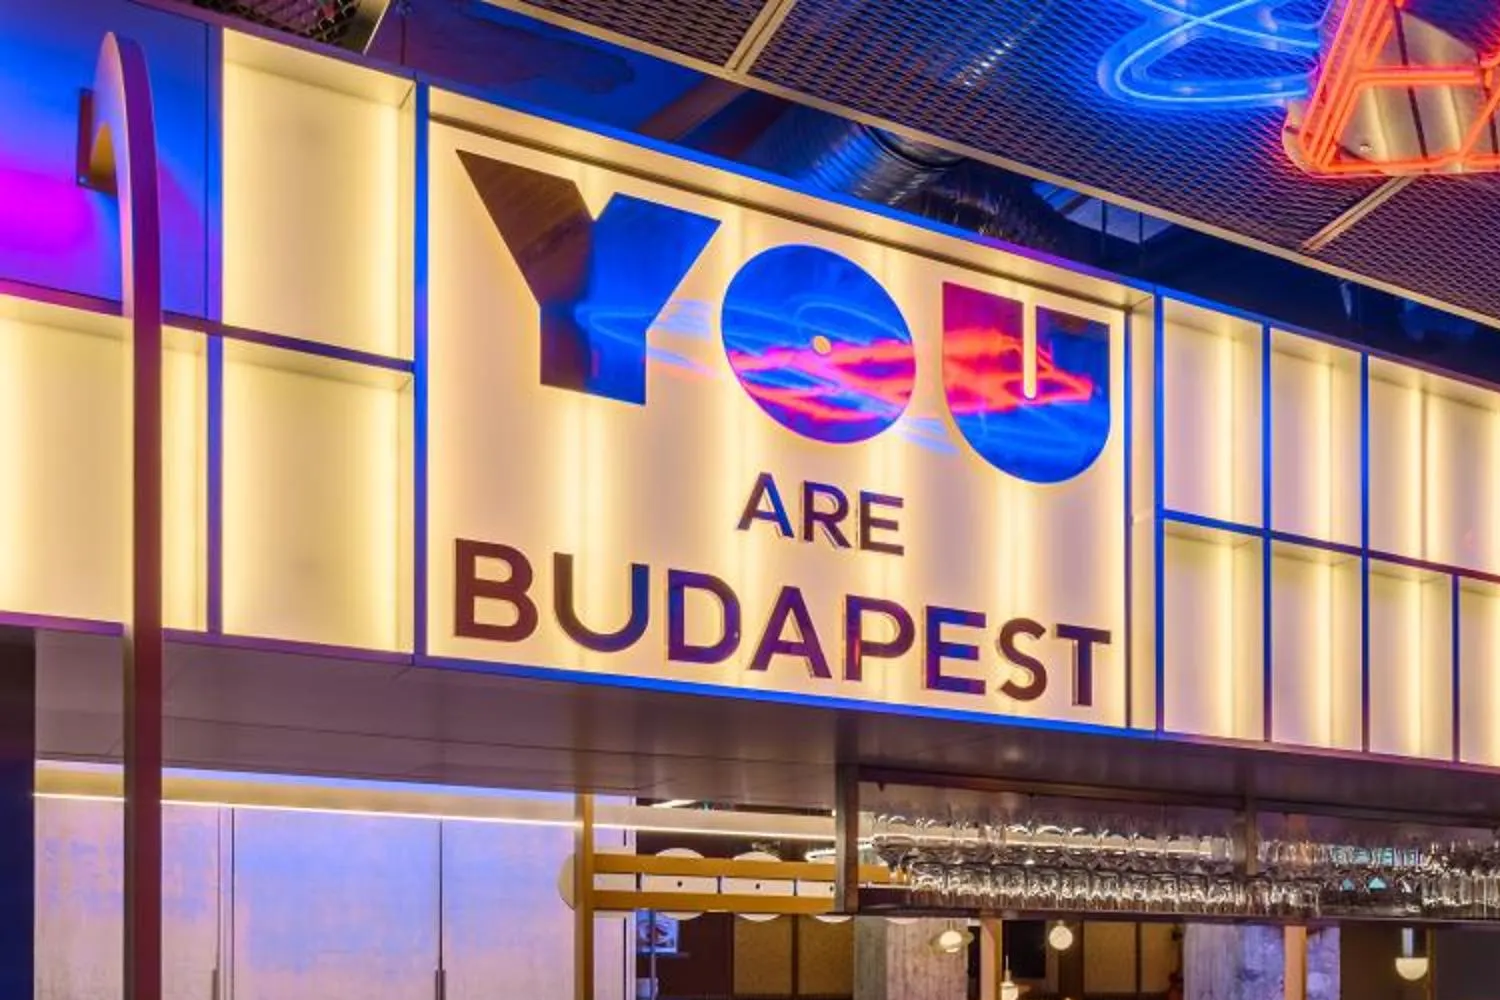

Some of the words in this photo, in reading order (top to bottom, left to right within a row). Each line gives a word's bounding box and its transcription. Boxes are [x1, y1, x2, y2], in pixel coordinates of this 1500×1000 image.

[455, 149, 1111, 485] YOU
[736, 472, 905, 556] ARE
[453, 537, 1112, 707] BUDAPEST
